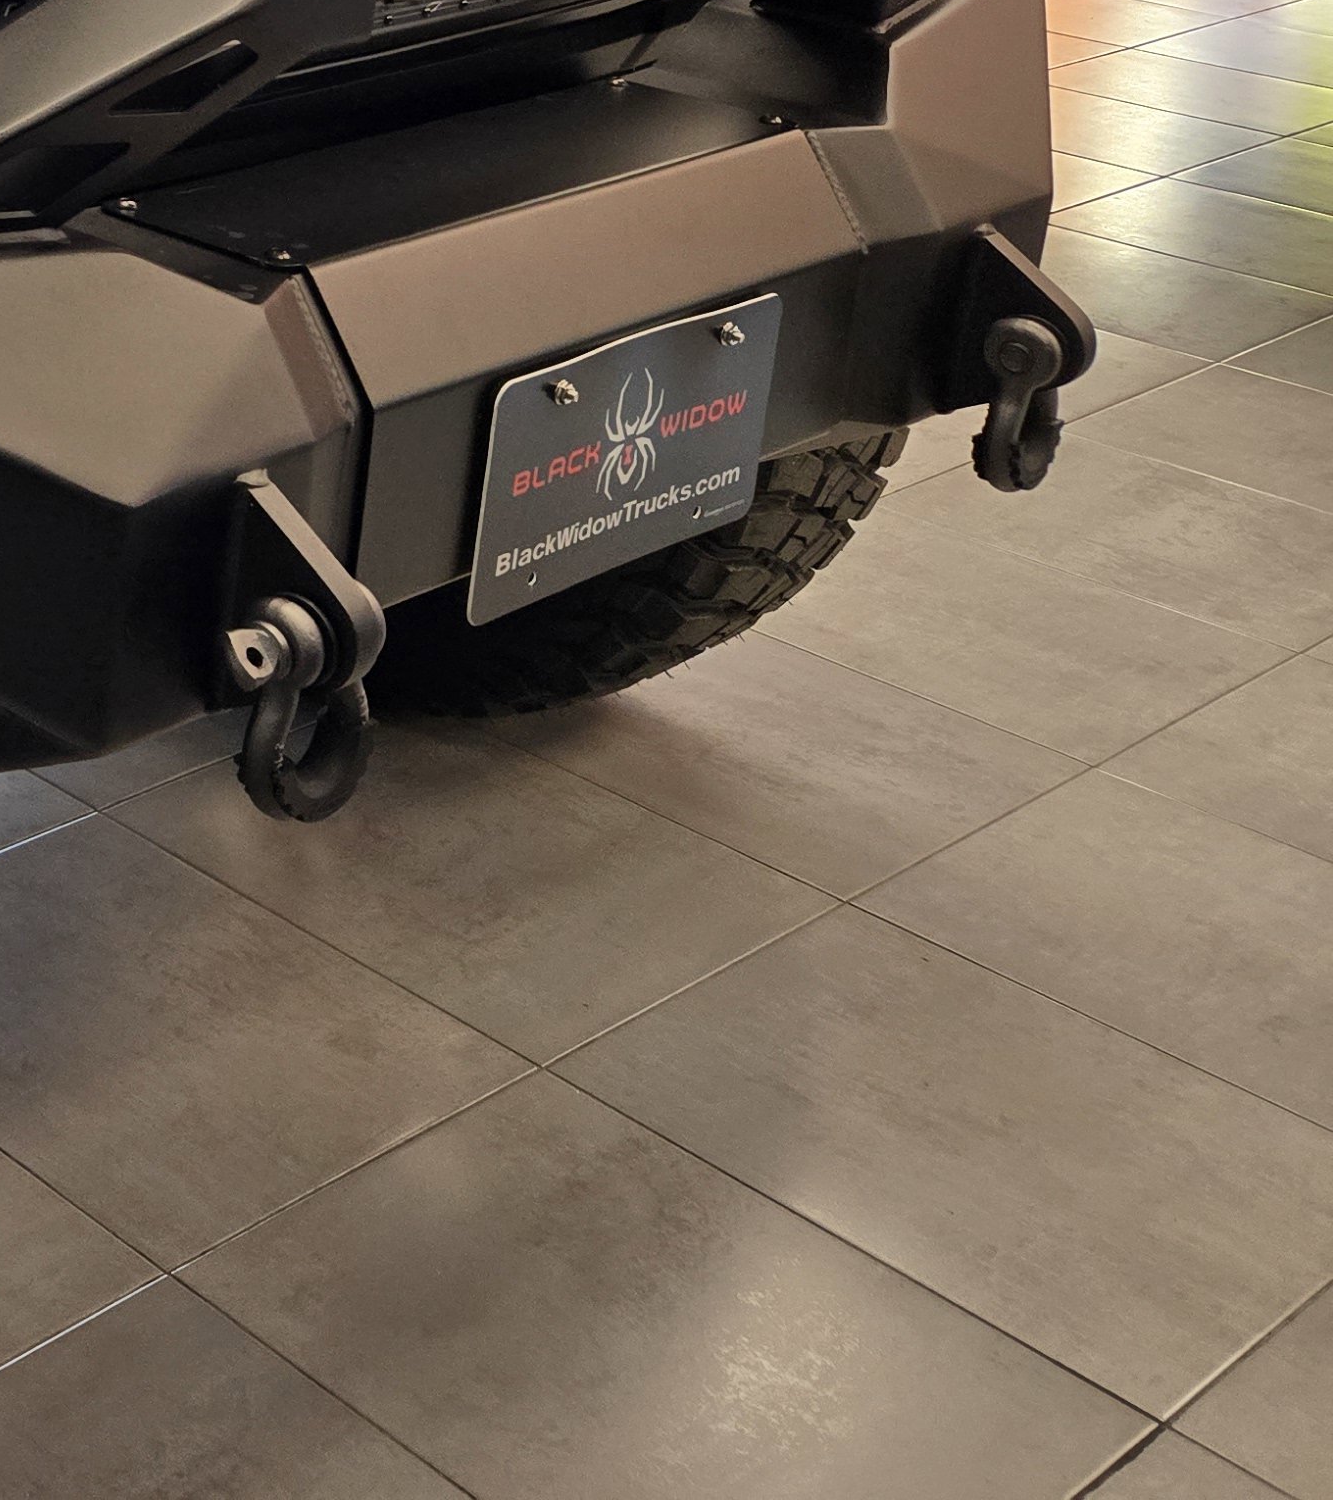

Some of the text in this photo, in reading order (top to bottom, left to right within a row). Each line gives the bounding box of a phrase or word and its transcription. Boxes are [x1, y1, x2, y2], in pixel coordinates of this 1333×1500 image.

[511, 389, 748, 498] BLACK WIDOW
[494, 464, 741, 578] BlackWidowTrucks.com
